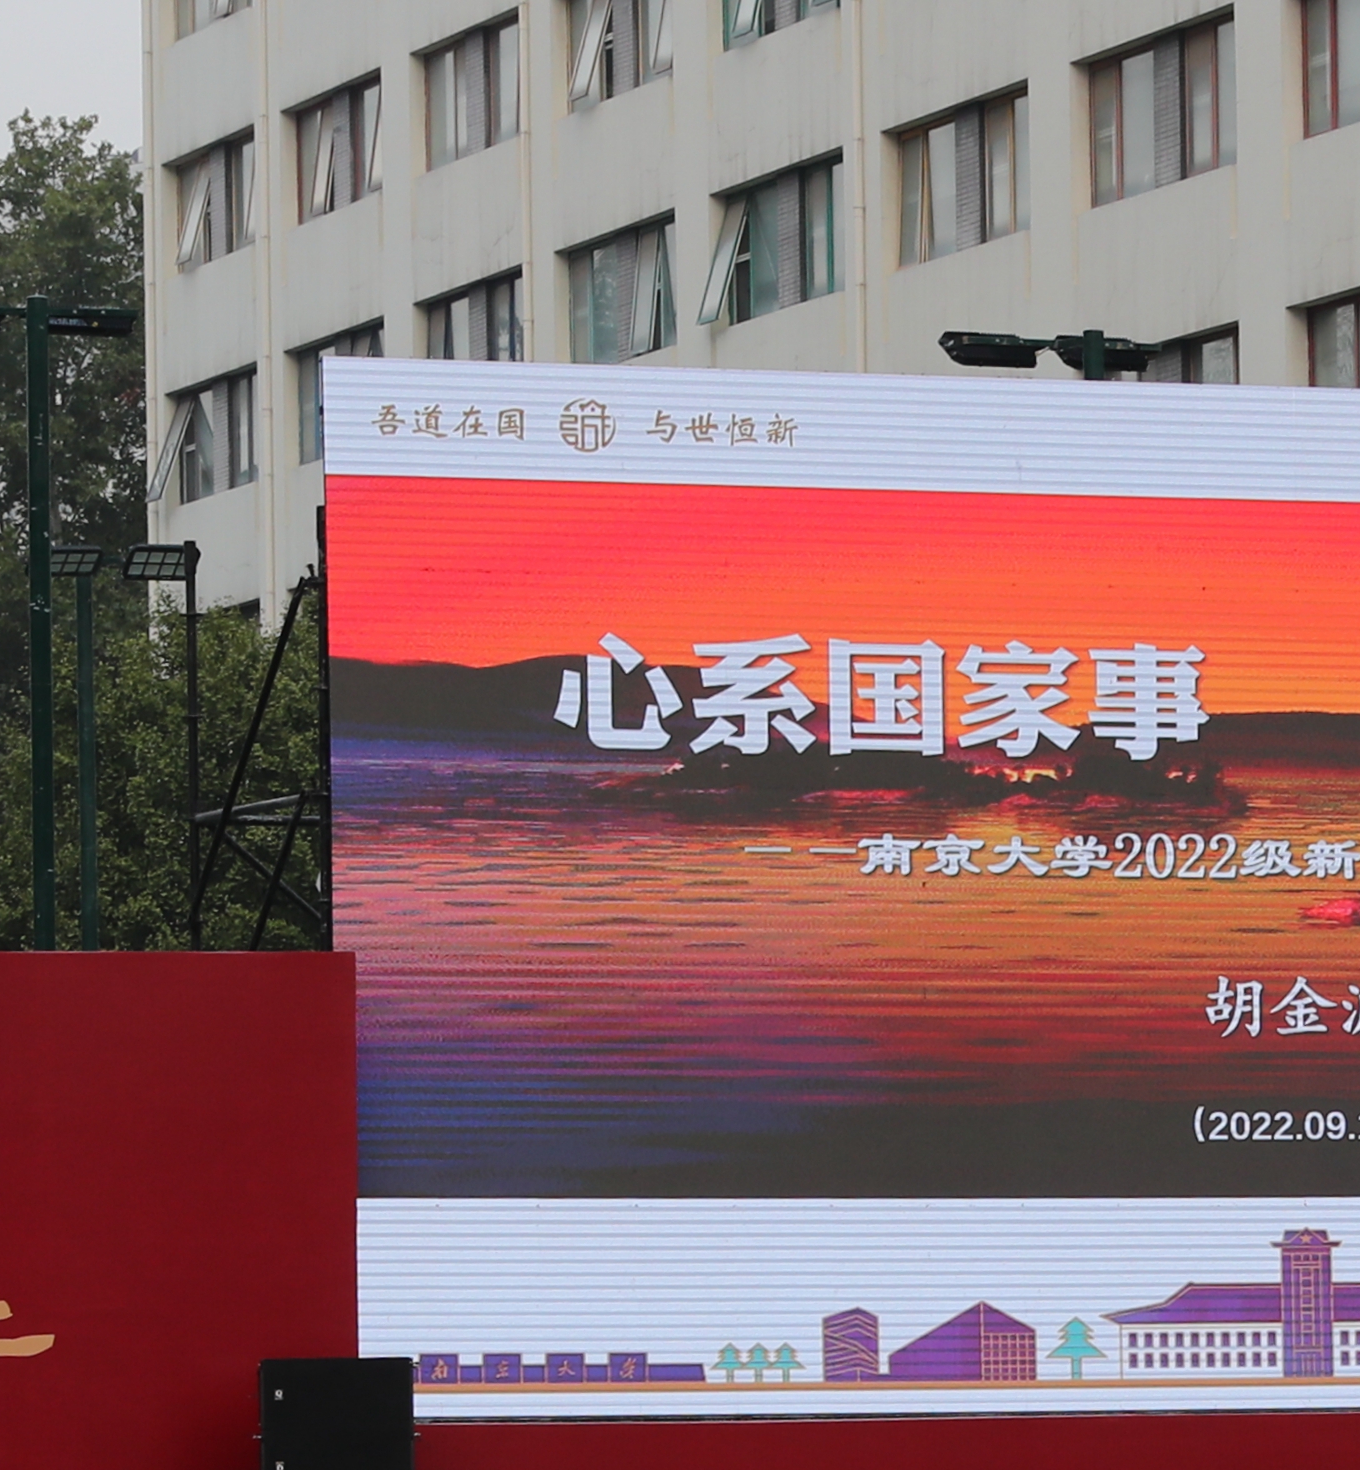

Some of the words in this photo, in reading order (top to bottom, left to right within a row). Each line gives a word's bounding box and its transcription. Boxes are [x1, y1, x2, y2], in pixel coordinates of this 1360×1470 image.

[371, 403, 527, 443] 吾道在国
[645, 410, 800, 450] 与世恒新
[552, 632, 1211, 762] 心系国家事
